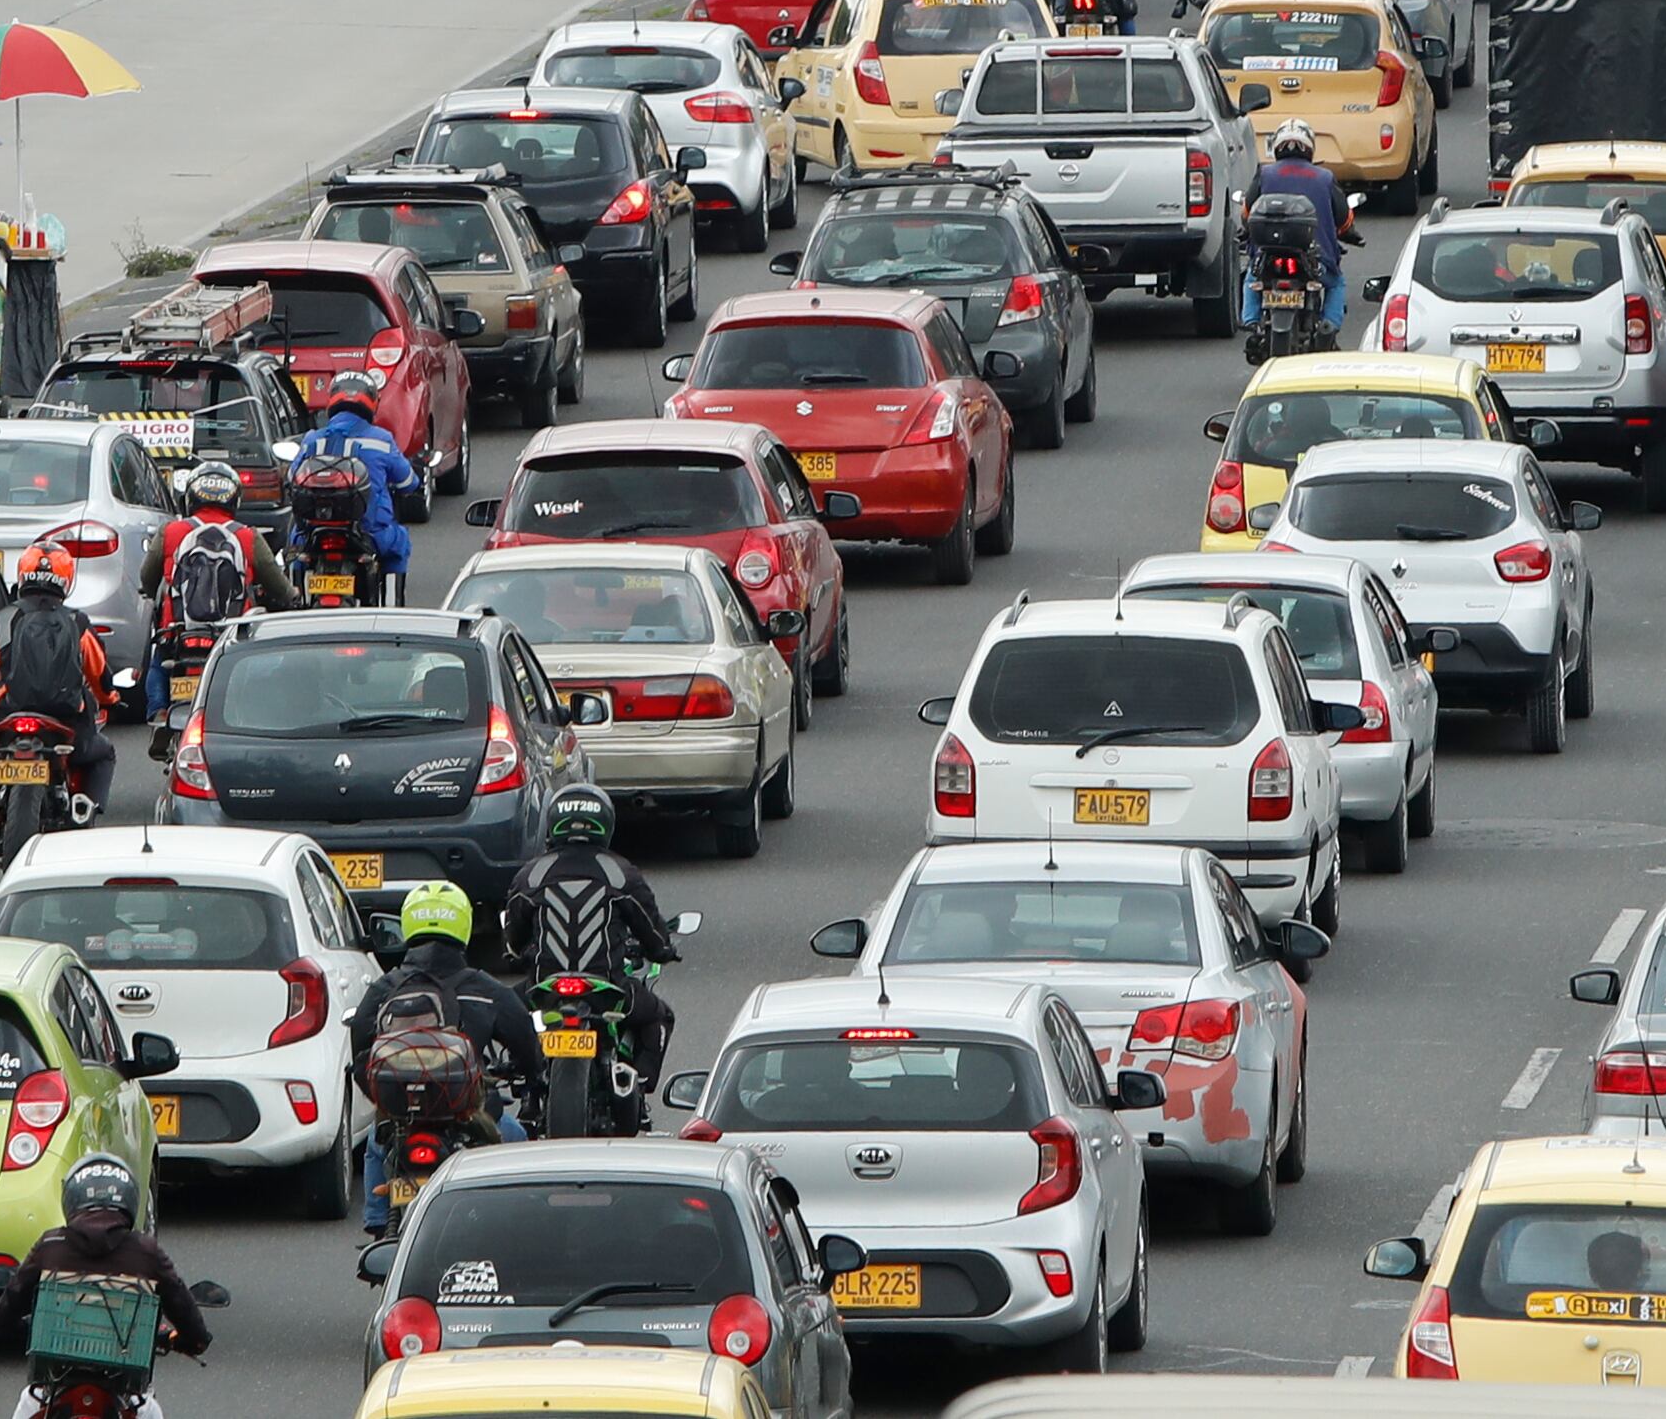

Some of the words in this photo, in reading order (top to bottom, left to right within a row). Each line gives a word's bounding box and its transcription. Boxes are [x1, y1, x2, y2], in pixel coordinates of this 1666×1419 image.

[120, 423, 190, 436] ELIGRO
[147, 437, 190, 446] LARGA
[534, 500, 583, 516] West
[394, 758, 461, 795] STEPWAY
[557, 801, 601, 814] YUT28D
[123, 986, 147, 999] KIA
[859, 1147, 889, 1159] KIA
[437, 1295, 515, 1305] BOGOTA
[1591, 1299, 1625, 1316] taxi
[447, 1323, 492, 1333] SPARK
[642, 1322, 702, 1330] CHEVROLET
